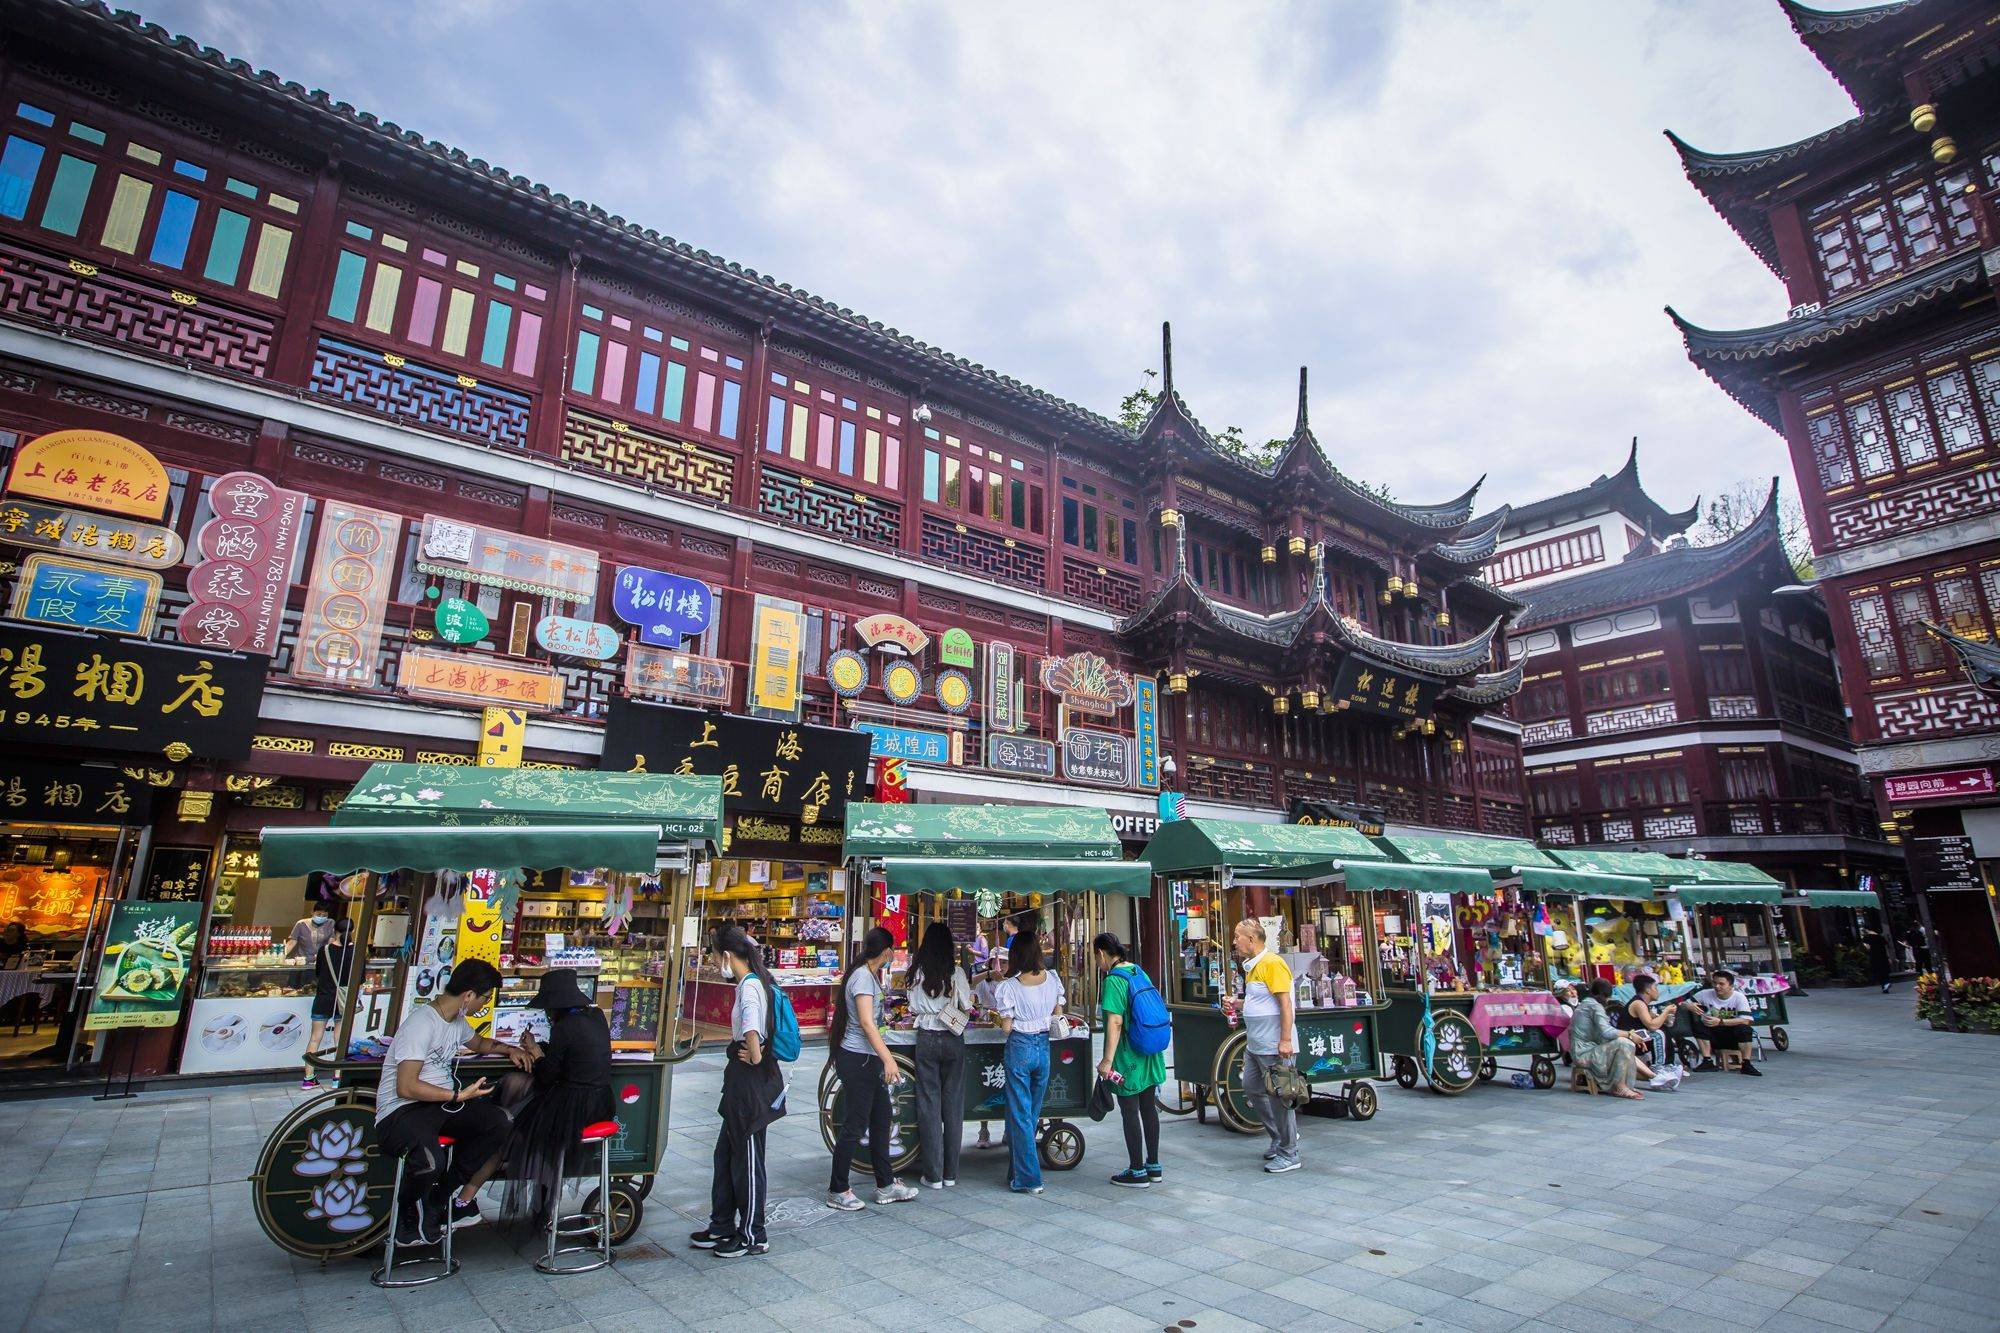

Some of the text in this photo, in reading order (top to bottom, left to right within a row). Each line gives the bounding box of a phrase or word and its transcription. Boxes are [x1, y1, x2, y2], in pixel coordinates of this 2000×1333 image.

[36, 435, 158, 478] SHANGHAI CLASSICAL RESTAURANT
[24, 461, 158, 502] 上海老饭店
[252, 497, 296, 649] TONG HAN 1783 CHUN TANG
[1071, 696, 1108, 711] Shanghai
[1350, 694, 1417, 716] SONG YUN TOWER
[1094, 739, 1123, 764] 老庙
[1894, 778, 1945, 793] 游园向前
[1108, 814, 1164, 834] OFFE
